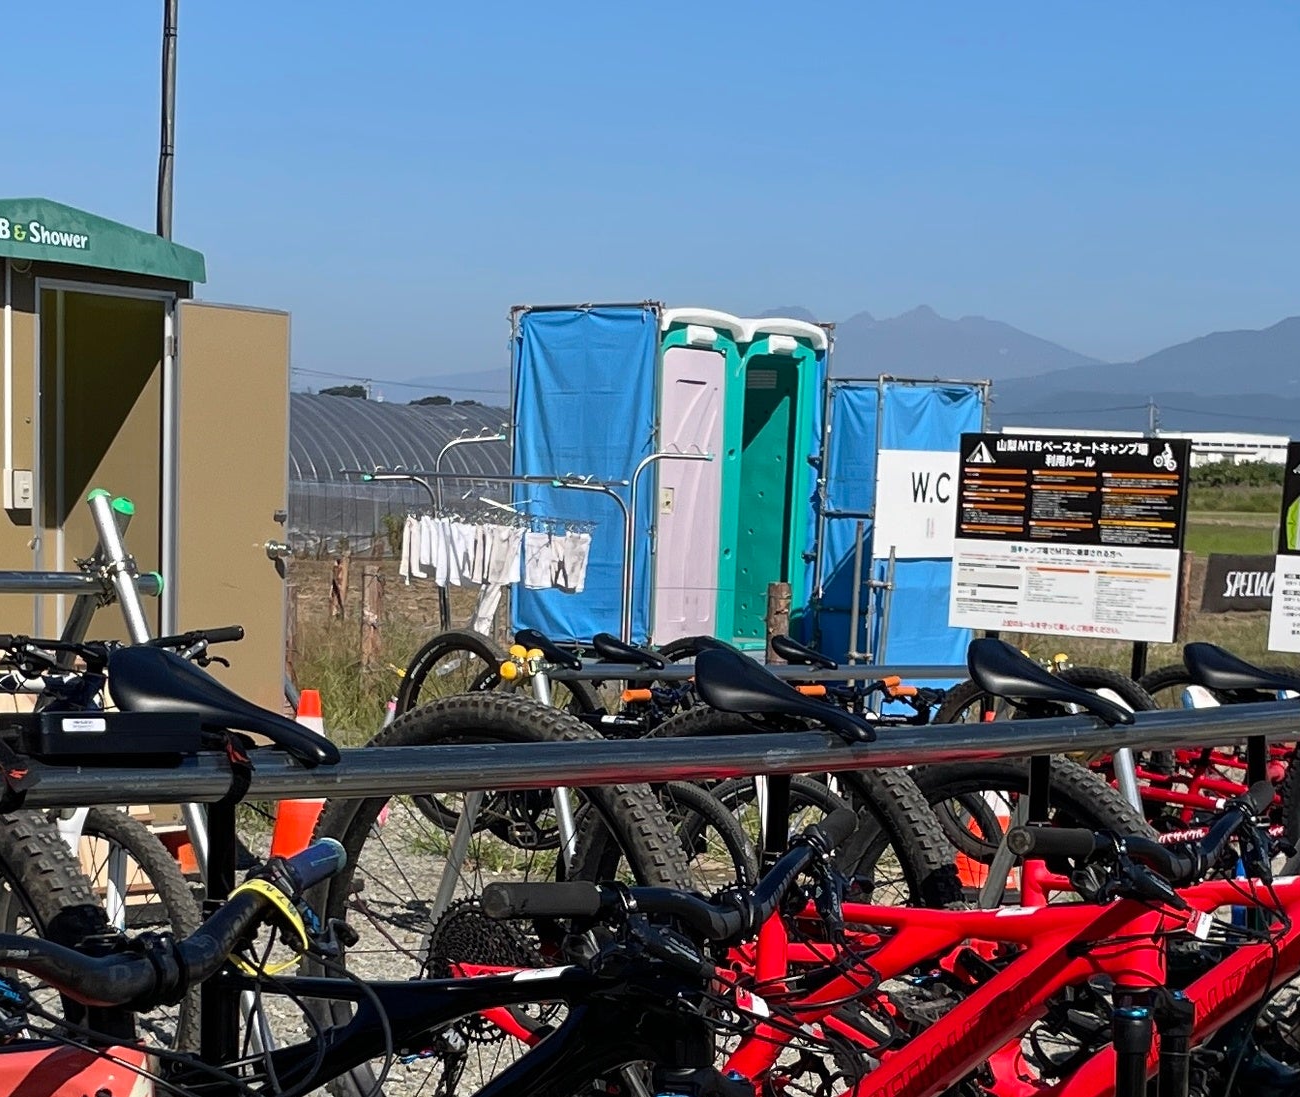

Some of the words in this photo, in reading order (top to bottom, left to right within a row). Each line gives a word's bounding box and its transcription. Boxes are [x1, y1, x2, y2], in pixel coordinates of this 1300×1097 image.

[13, 224, 27, 241] &
[29, 221, 88, 249] Shower
[1044, 454, 1096, 468] 利用ルール
[911, 472, 951, 504] W.C
[1222, 571, 1276, 597] SPECIAL
